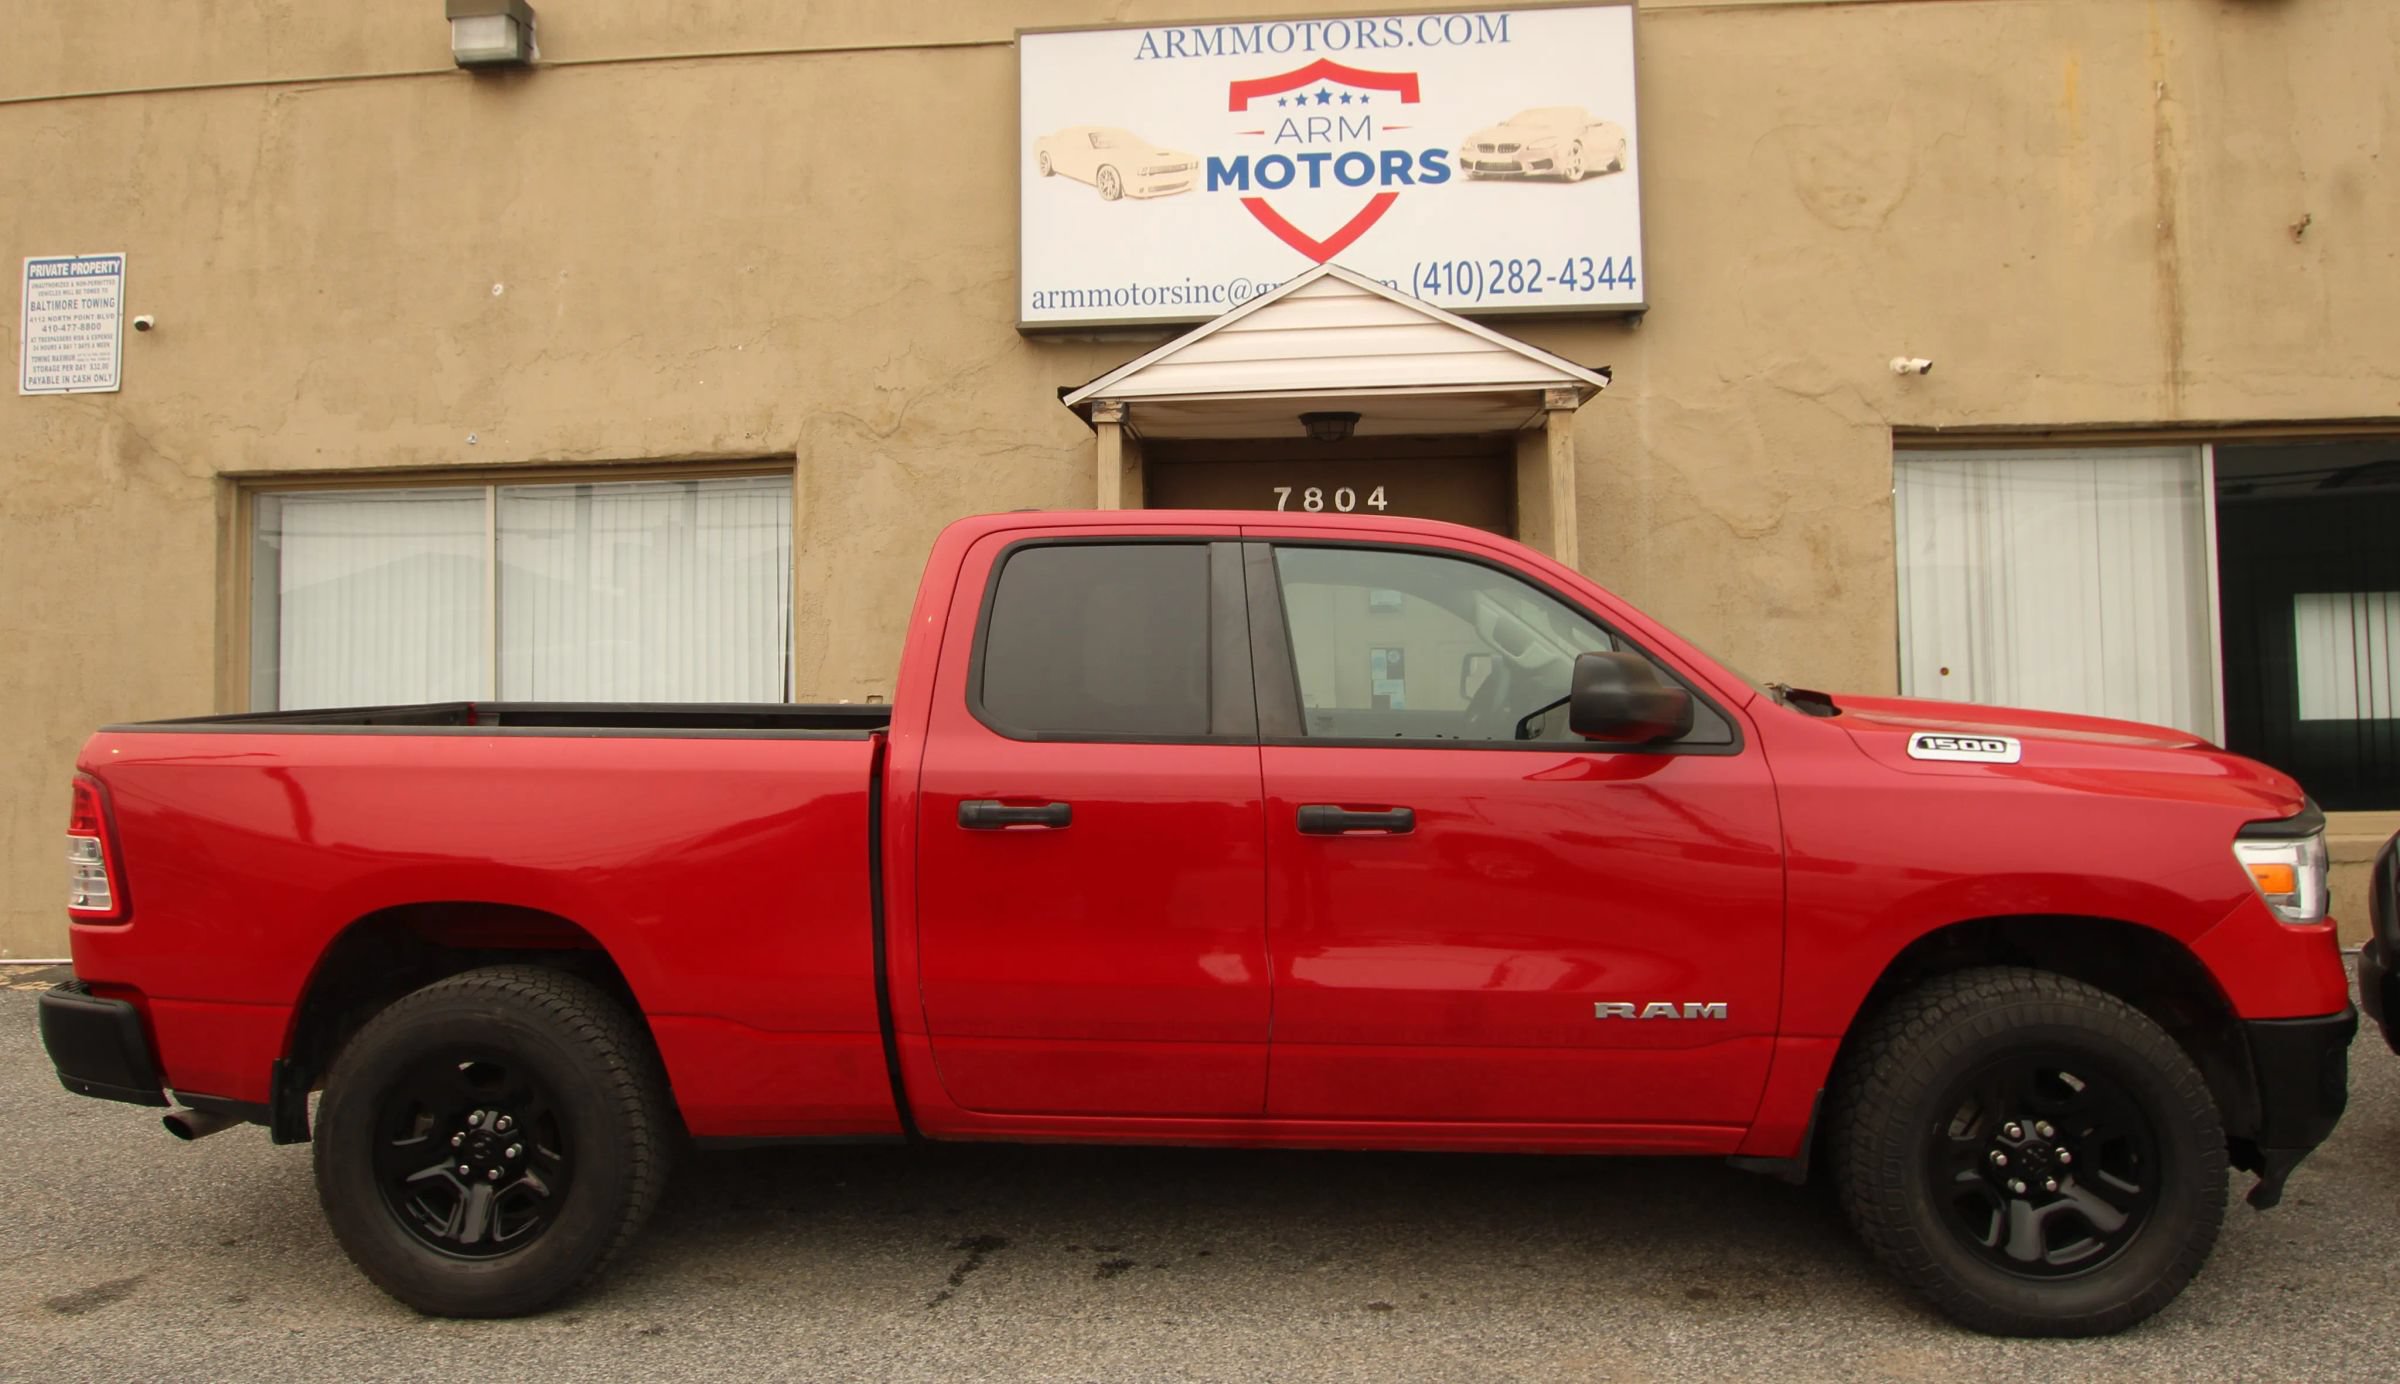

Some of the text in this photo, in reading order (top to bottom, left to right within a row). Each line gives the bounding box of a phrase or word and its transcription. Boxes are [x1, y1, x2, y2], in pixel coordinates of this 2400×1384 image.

[1133, 14, 1512, 60] ARMMOTORS.COM
[1274, 114, 1372, 144] ARM
[1206, 148, 1452, 192] MOTORS
[29, 261, 120, 277] PRIVATE PROPERTY
[1413, 255, 1637, 302] (410)282-4344
[30, 297, 115, 311] BALTIMORE TOWING
[42, 323, 101, 333] 410-477-8800
[33, 365, 60, 373] STORAGE
[28, 373, 112, 385] PAYABLE IN CASH ONLY
[1273, 485, 1388, 512] 7804
[1917, 735, 2007, 753] 1500
[1594, 1002, 1728, 1019] RAM
